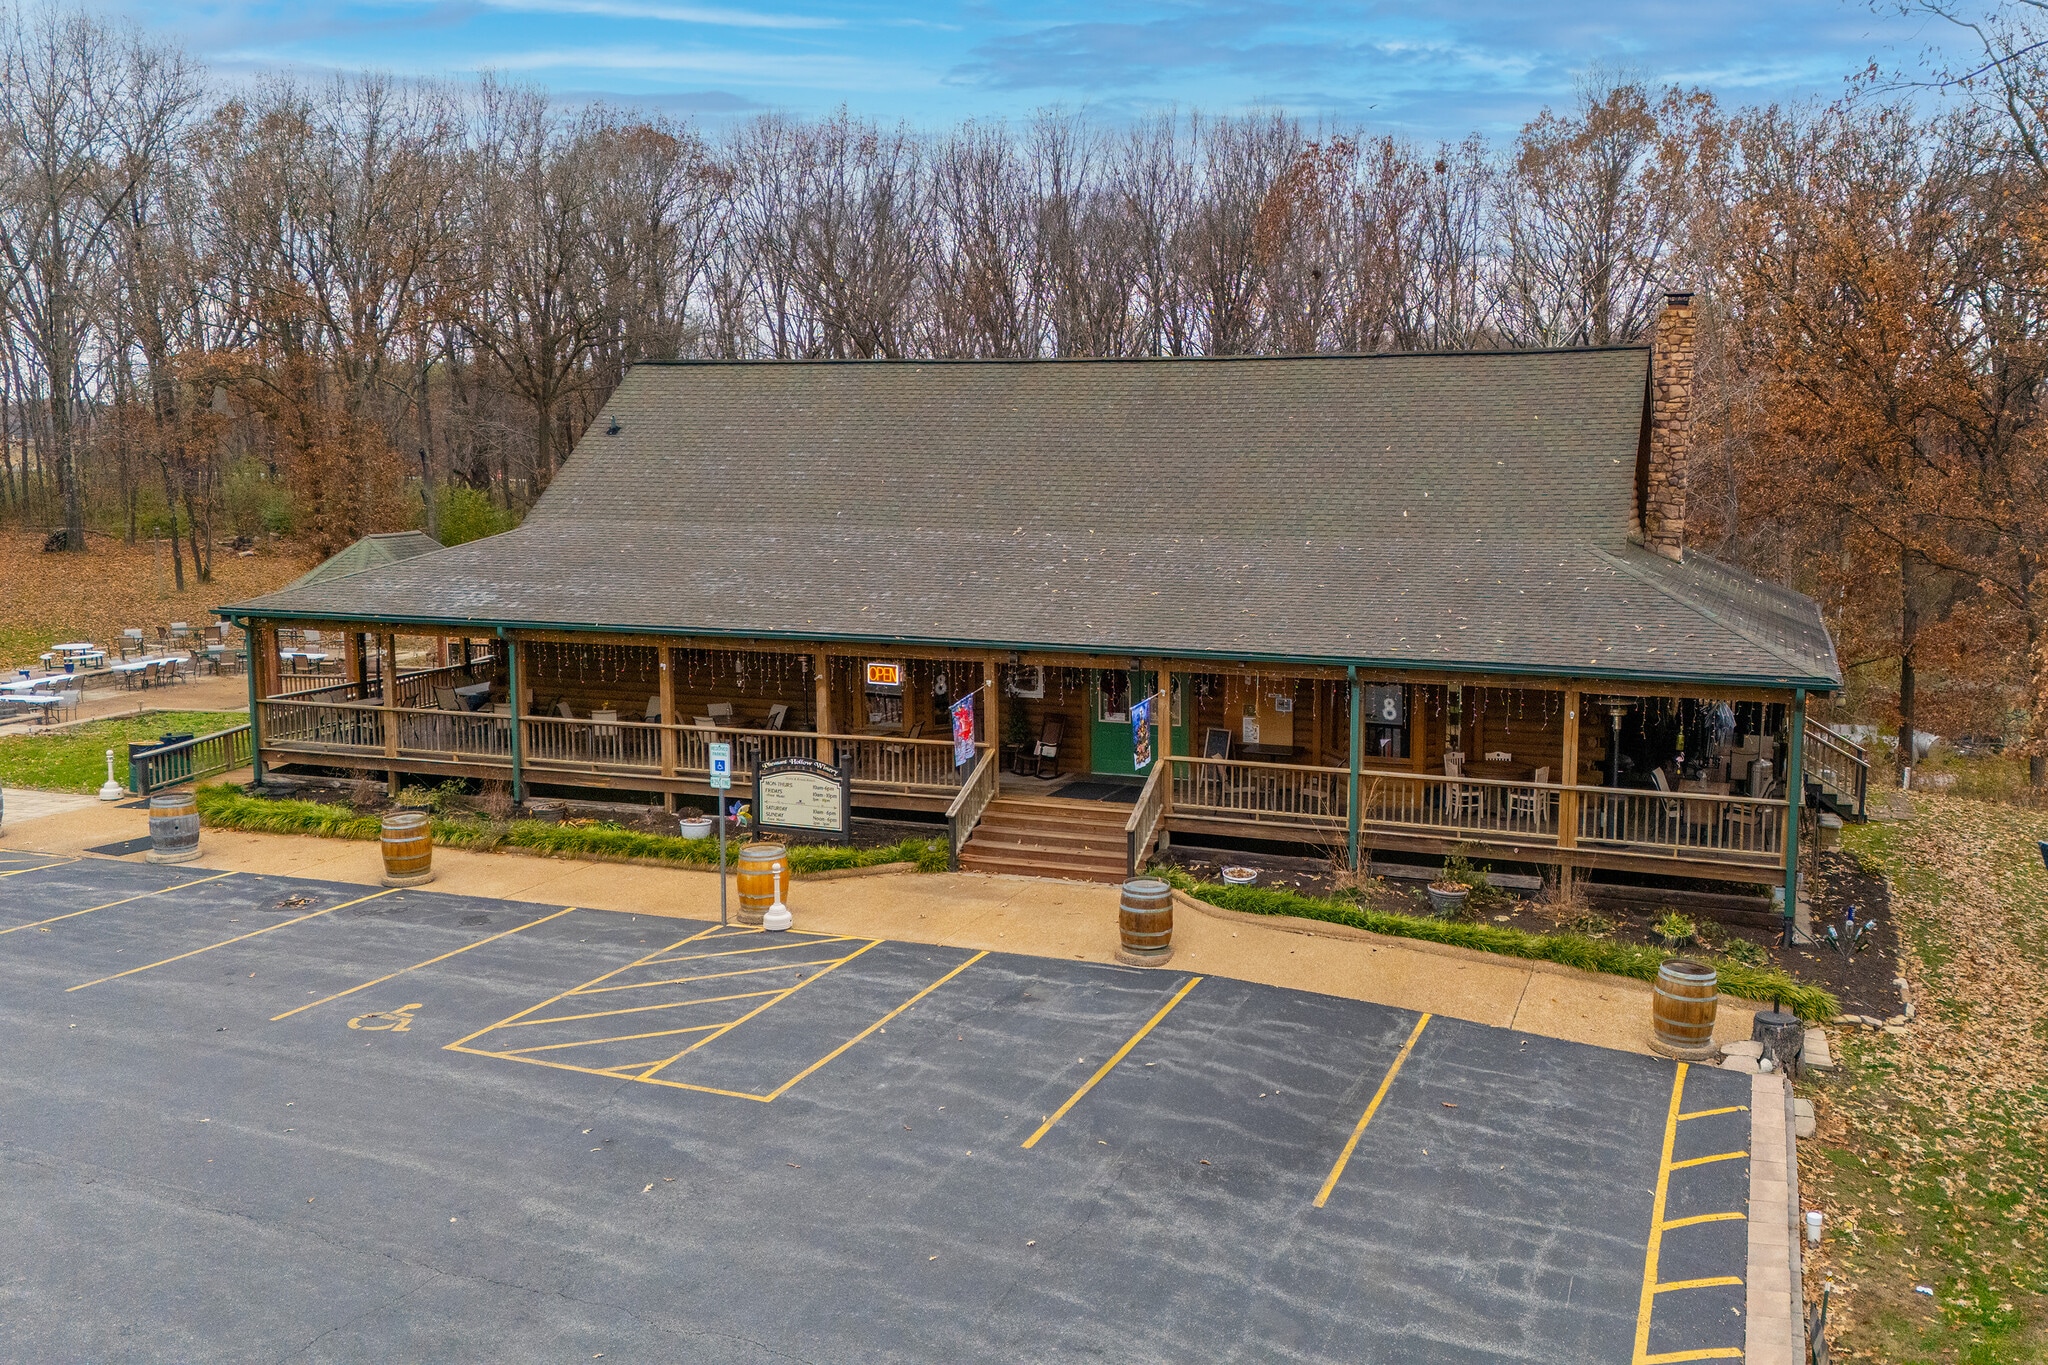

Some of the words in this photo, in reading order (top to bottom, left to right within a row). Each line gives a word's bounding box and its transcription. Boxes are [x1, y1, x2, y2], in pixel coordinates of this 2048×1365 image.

[869, 666, 897, 682] OPEN
[789, 758, 813, 766] Hollow
[813, 762, 839, 776] Winery
